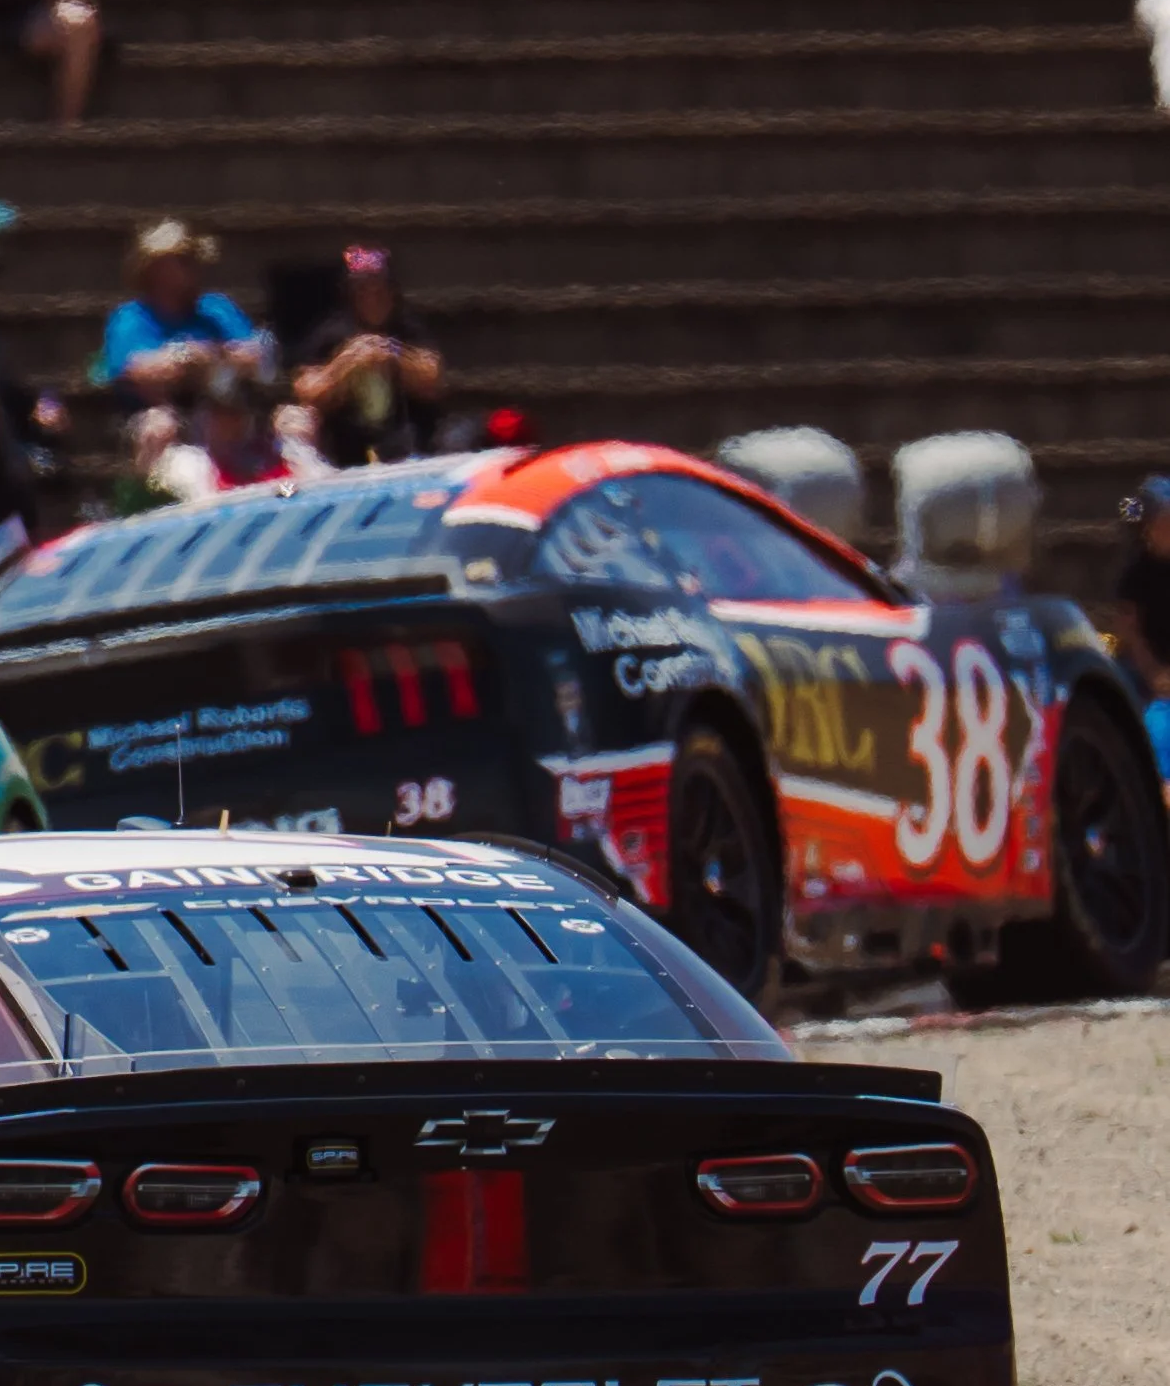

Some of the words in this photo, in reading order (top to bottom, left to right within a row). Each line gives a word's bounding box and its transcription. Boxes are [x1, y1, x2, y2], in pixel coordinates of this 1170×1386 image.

[886, 637, 1012, 869] 38
[395, 776, 456, 827] 38
[857, 1240, 959, 1306] 77
